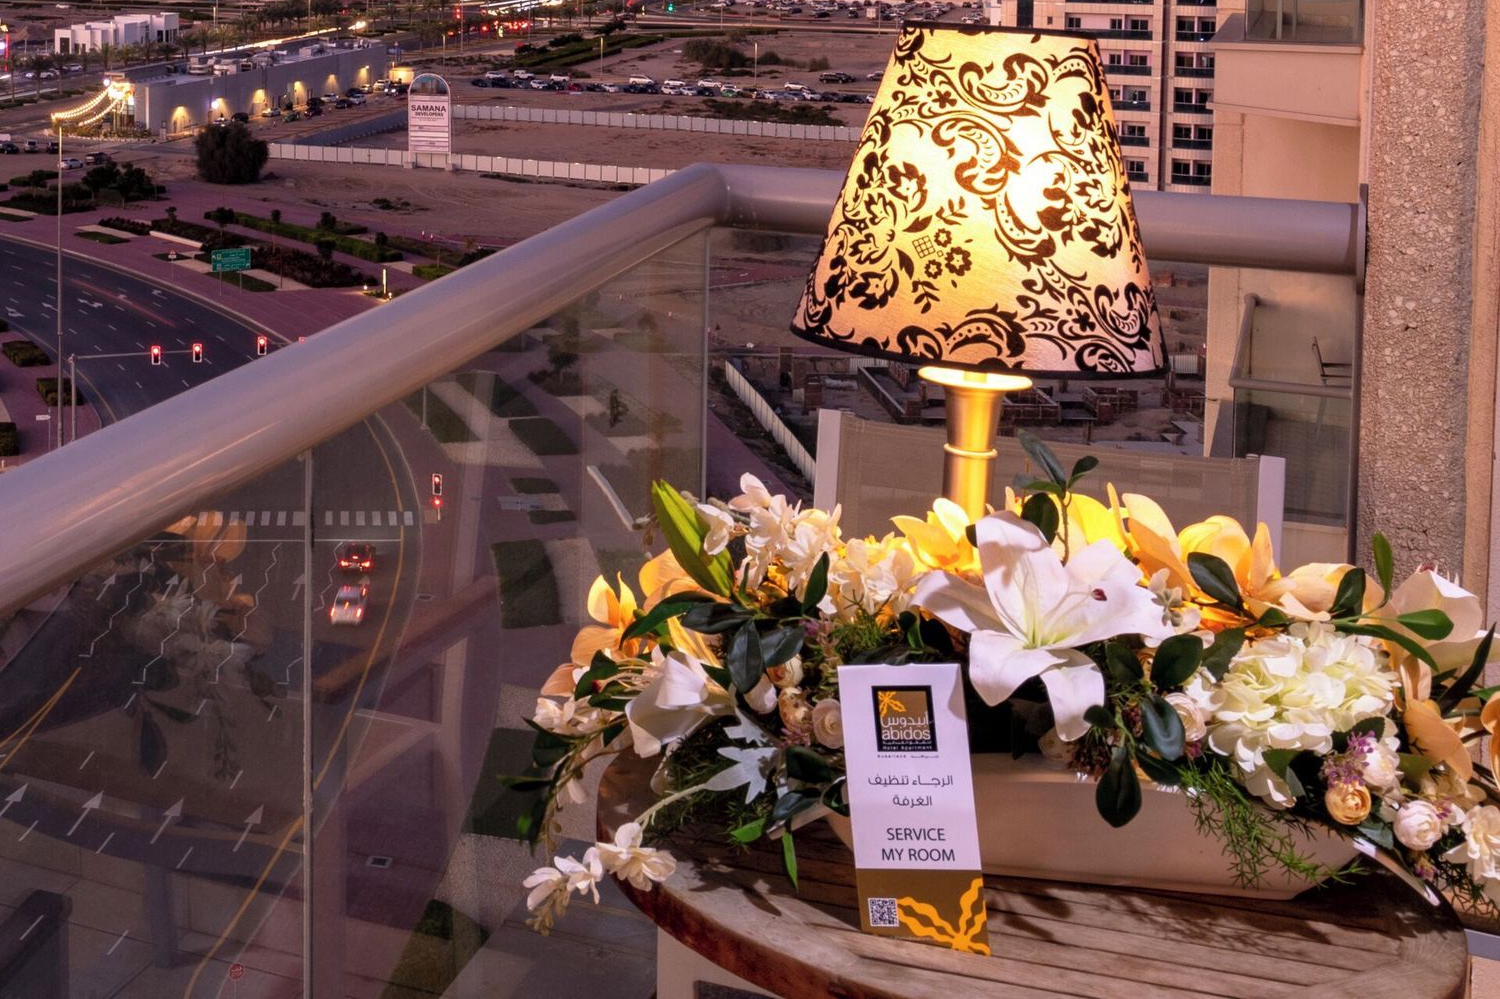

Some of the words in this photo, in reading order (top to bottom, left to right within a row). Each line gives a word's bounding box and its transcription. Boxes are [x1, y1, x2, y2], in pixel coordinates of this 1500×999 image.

[882, 726, 931, 740] abidos
[868, 773, 909, 787] تنظيف
[892, 794, 932, 808] الغرفة
[886, 828, 946, 841] SERVICE
[881, 848, 904, 861] MY
[908, 848, 955, 861] ROOM
